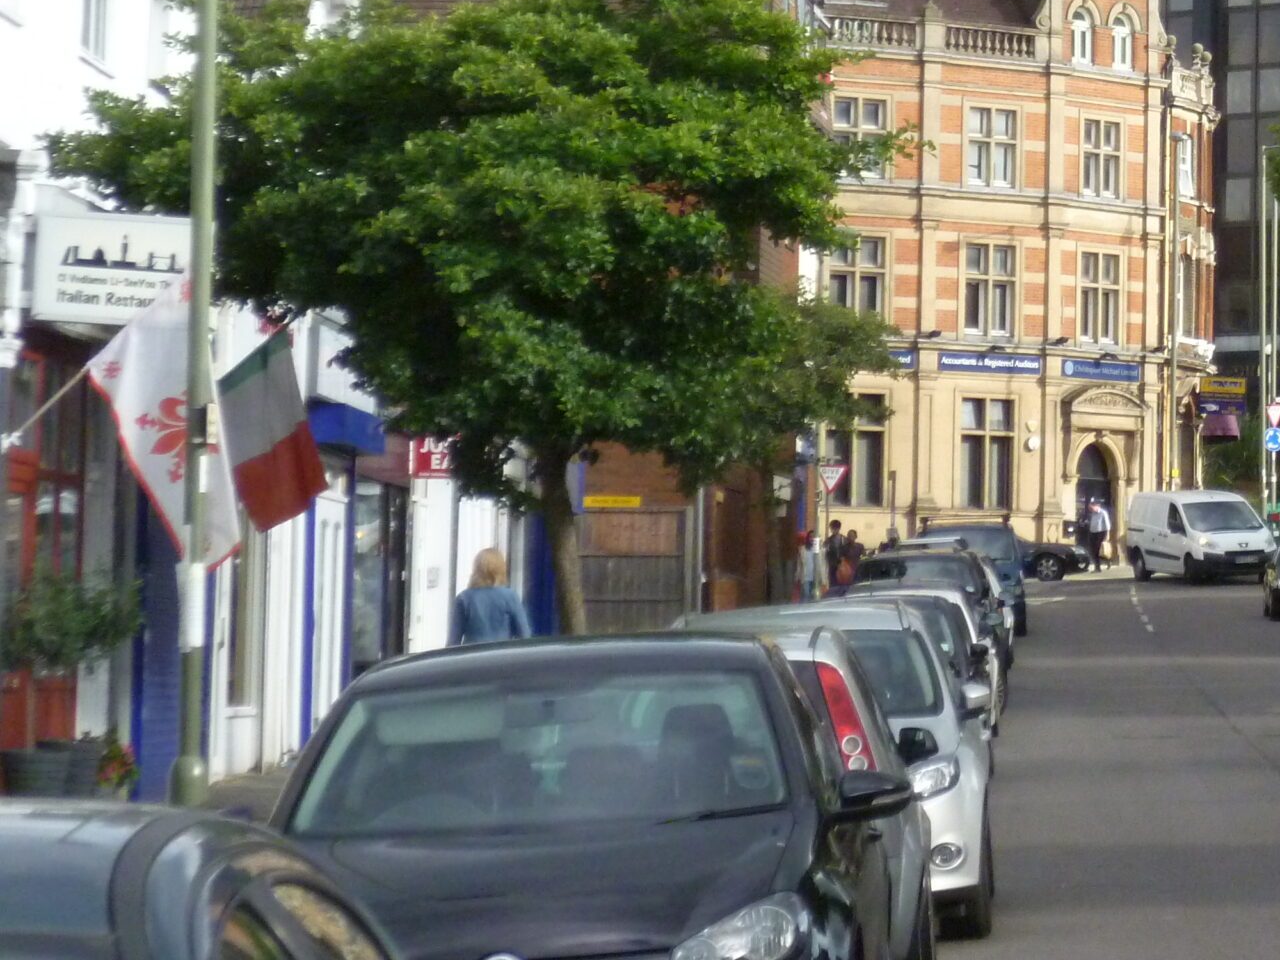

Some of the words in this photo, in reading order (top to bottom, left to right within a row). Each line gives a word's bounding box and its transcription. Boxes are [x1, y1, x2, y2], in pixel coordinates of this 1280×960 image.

[56, 289, 100, 305] Italian
[941, 355, 977, 366] Accountants
[984, 357, 1014, 368] Registered
[1014, 359, 1040, 369] Auditors
[821, 467, 840, 475] GIVE
